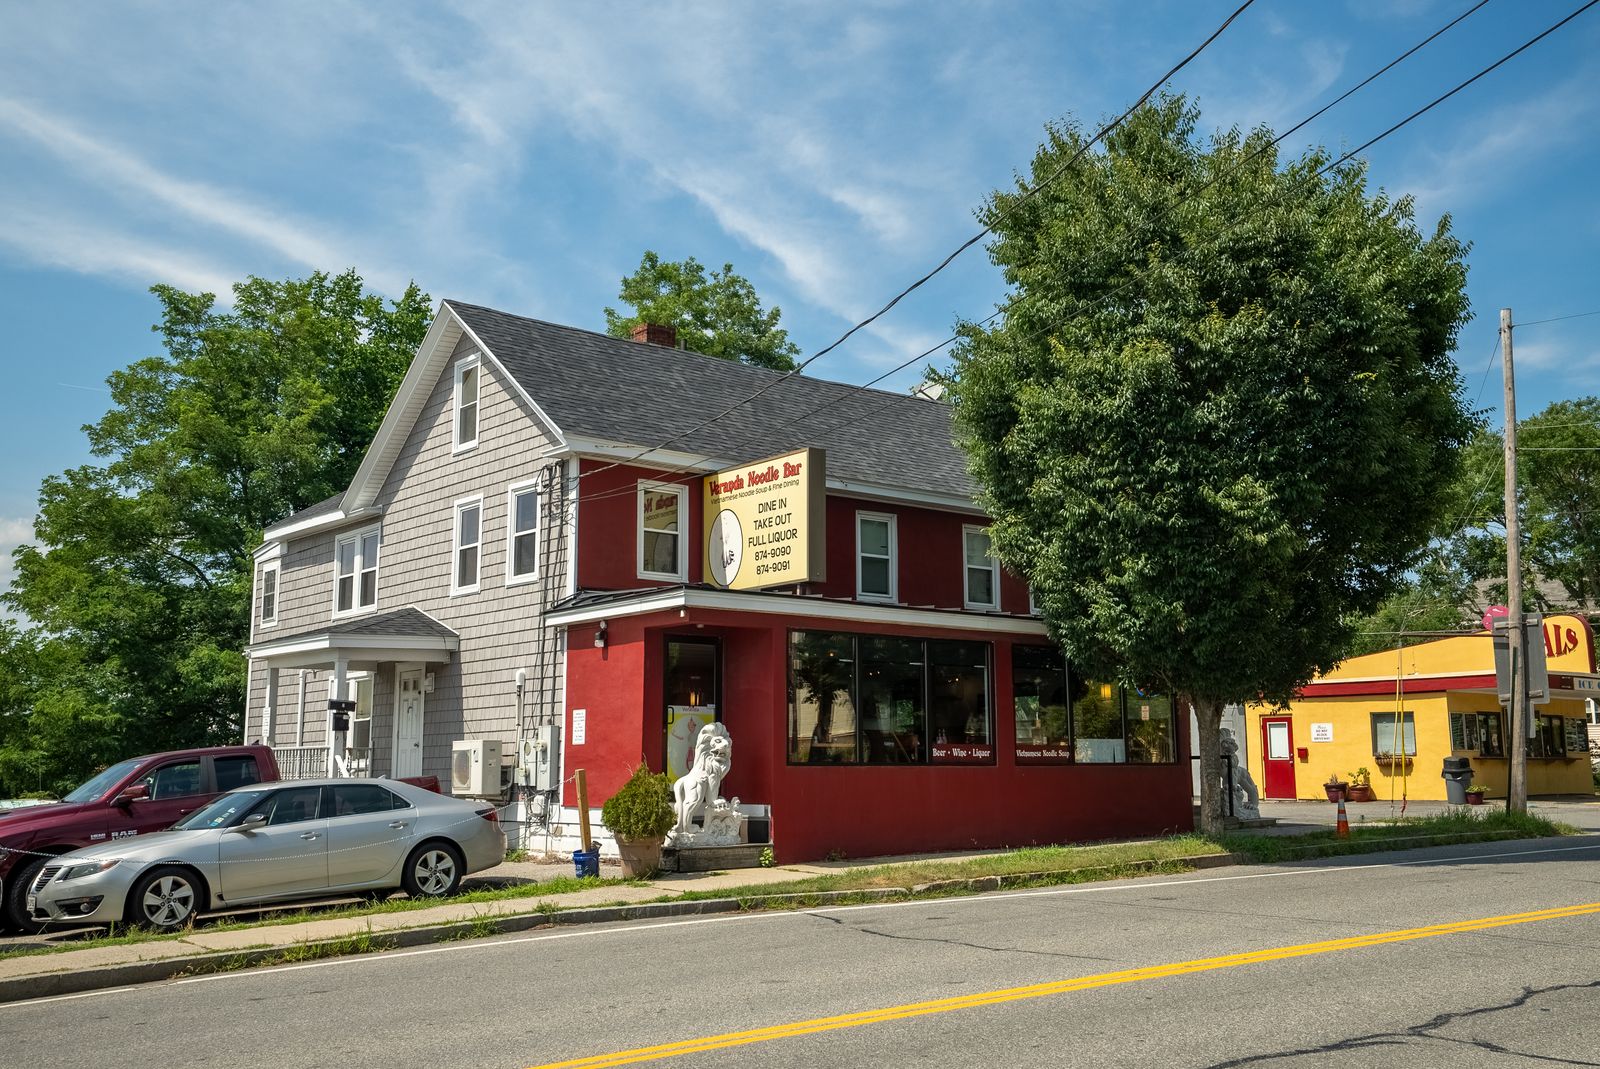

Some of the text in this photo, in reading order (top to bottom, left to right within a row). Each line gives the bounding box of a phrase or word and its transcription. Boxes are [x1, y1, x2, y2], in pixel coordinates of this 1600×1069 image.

[709, 462, 802, 496] Veranda Noodle Bar
[711, 494, 738, 505] Vietnamese
[738, 487, 755, 498] Noodle
[755, 485, 768, 495] Soup
[783, 479, 800, 488] Dining
[758, 498, 787, 514] DINE IN
[754, 513, 792, 530] TAKE OUT
[748, 528, 798, 548] FULL LIQUOR
[754, 546, 792, 561] 874-9090
[756, 560, 790, 575] 874-9091
[932, 748, 990, 758] Beer Wine Liquor
[1016, 750, 1042, 758] Vietnamese
